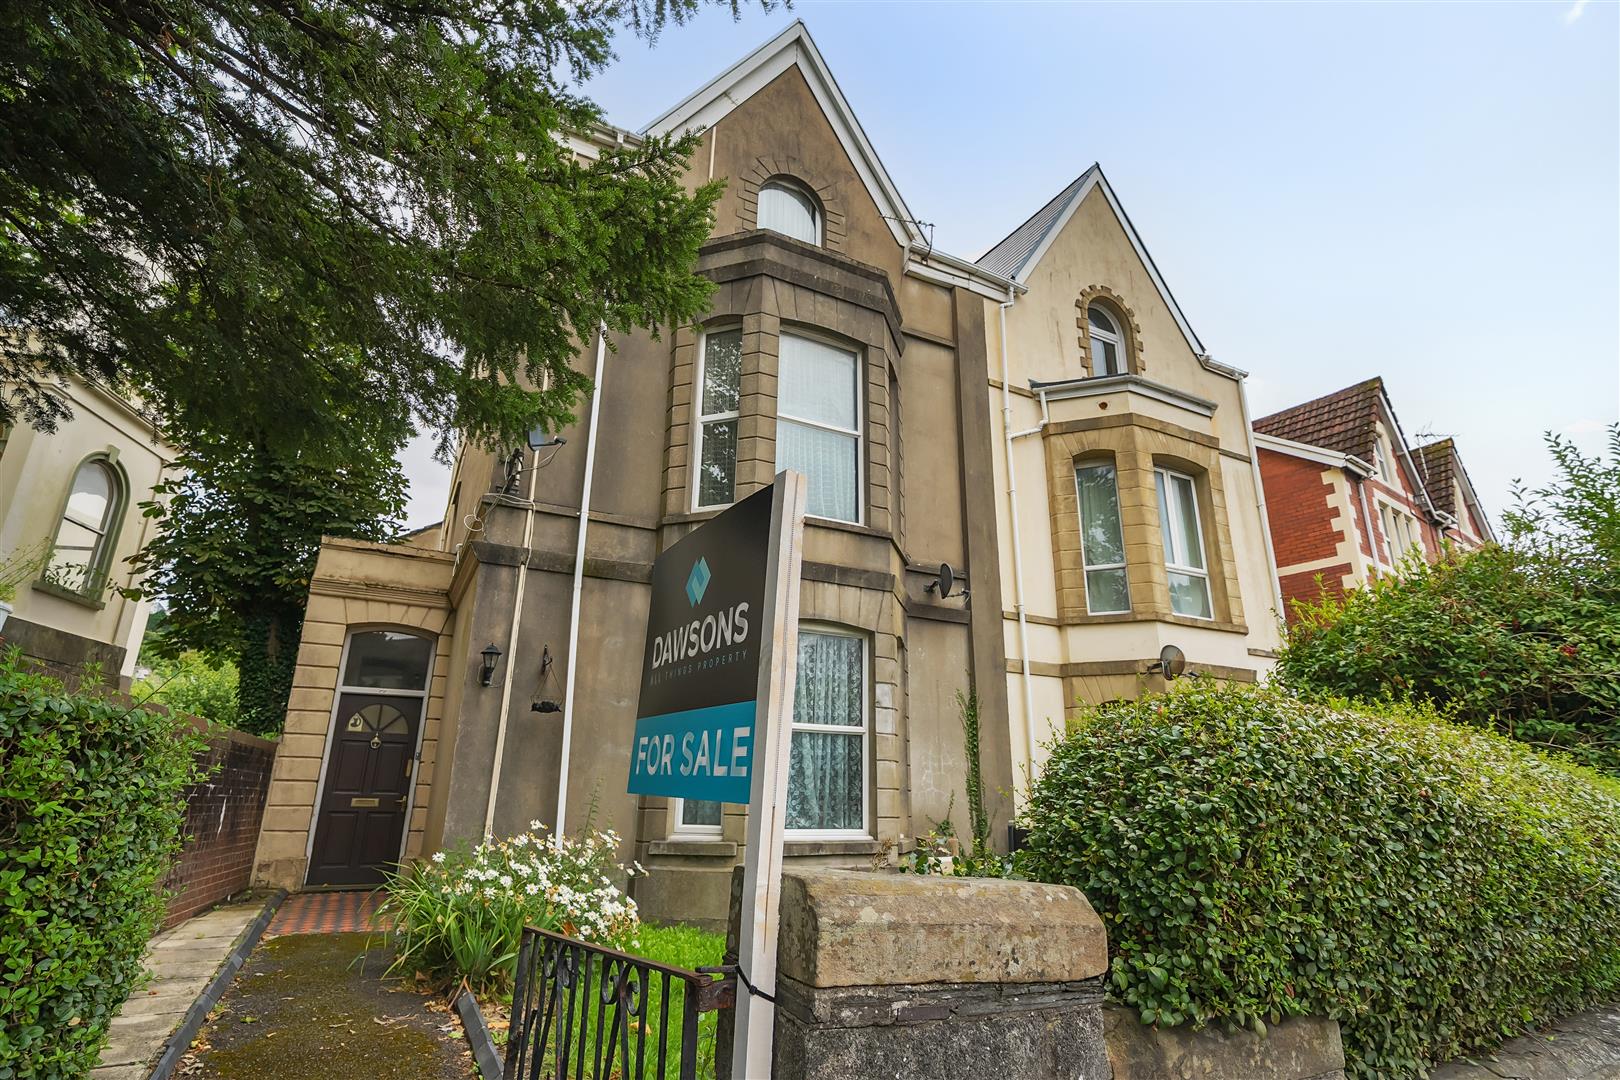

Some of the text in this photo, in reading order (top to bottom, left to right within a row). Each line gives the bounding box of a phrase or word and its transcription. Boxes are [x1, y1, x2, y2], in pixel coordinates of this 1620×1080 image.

[652, 602, 749, 669] DAWSONS
[698, 648, 747, 671] PROPERTY
[636, 726, 751, 777] FOR SALE
